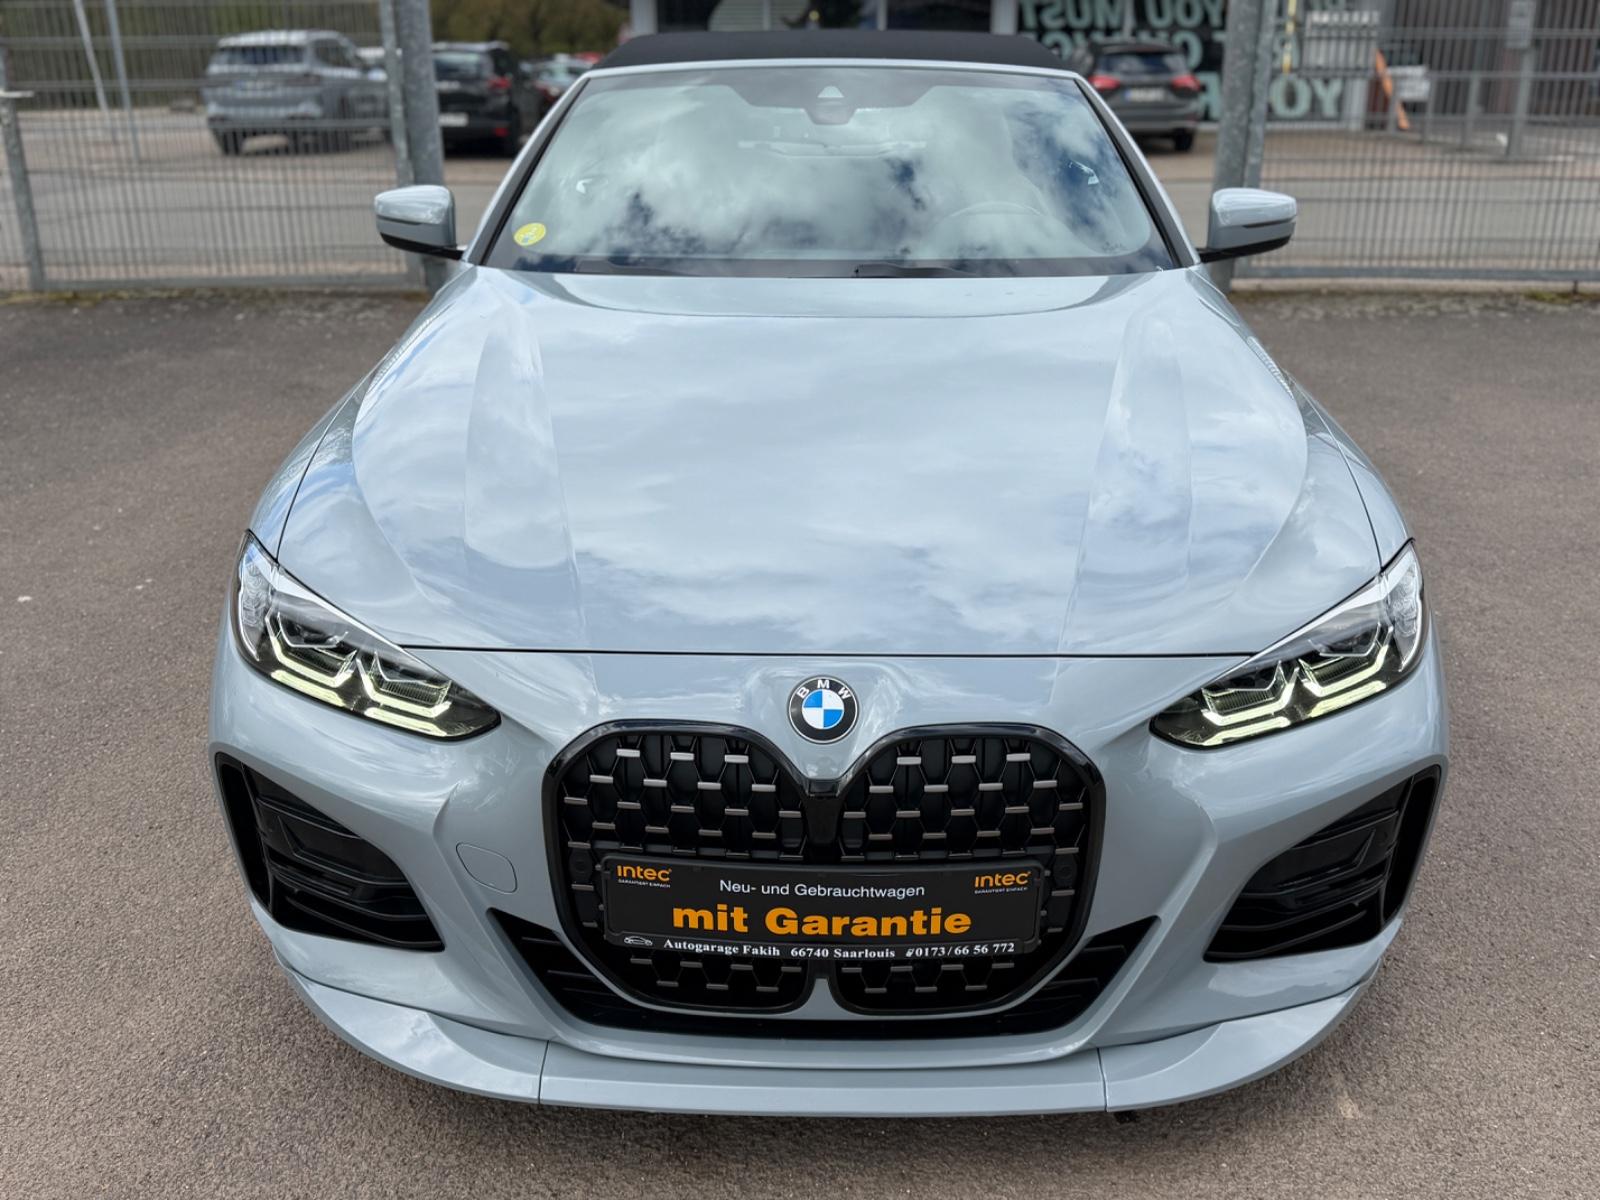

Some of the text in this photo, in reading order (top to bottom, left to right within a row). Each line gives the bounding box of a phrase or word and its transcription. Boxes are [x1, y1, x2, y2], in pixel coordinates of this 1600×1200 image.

[796, 679, 851, 700] BMW
[720, 880, 925, 899] Neu- und Gebrauchtwagen
[673, 904, 971, 936] mit Garantie
[664, 939, 1014, 958] Autogarage Fakih 66740 Saarlouis 0173/66 56 772
